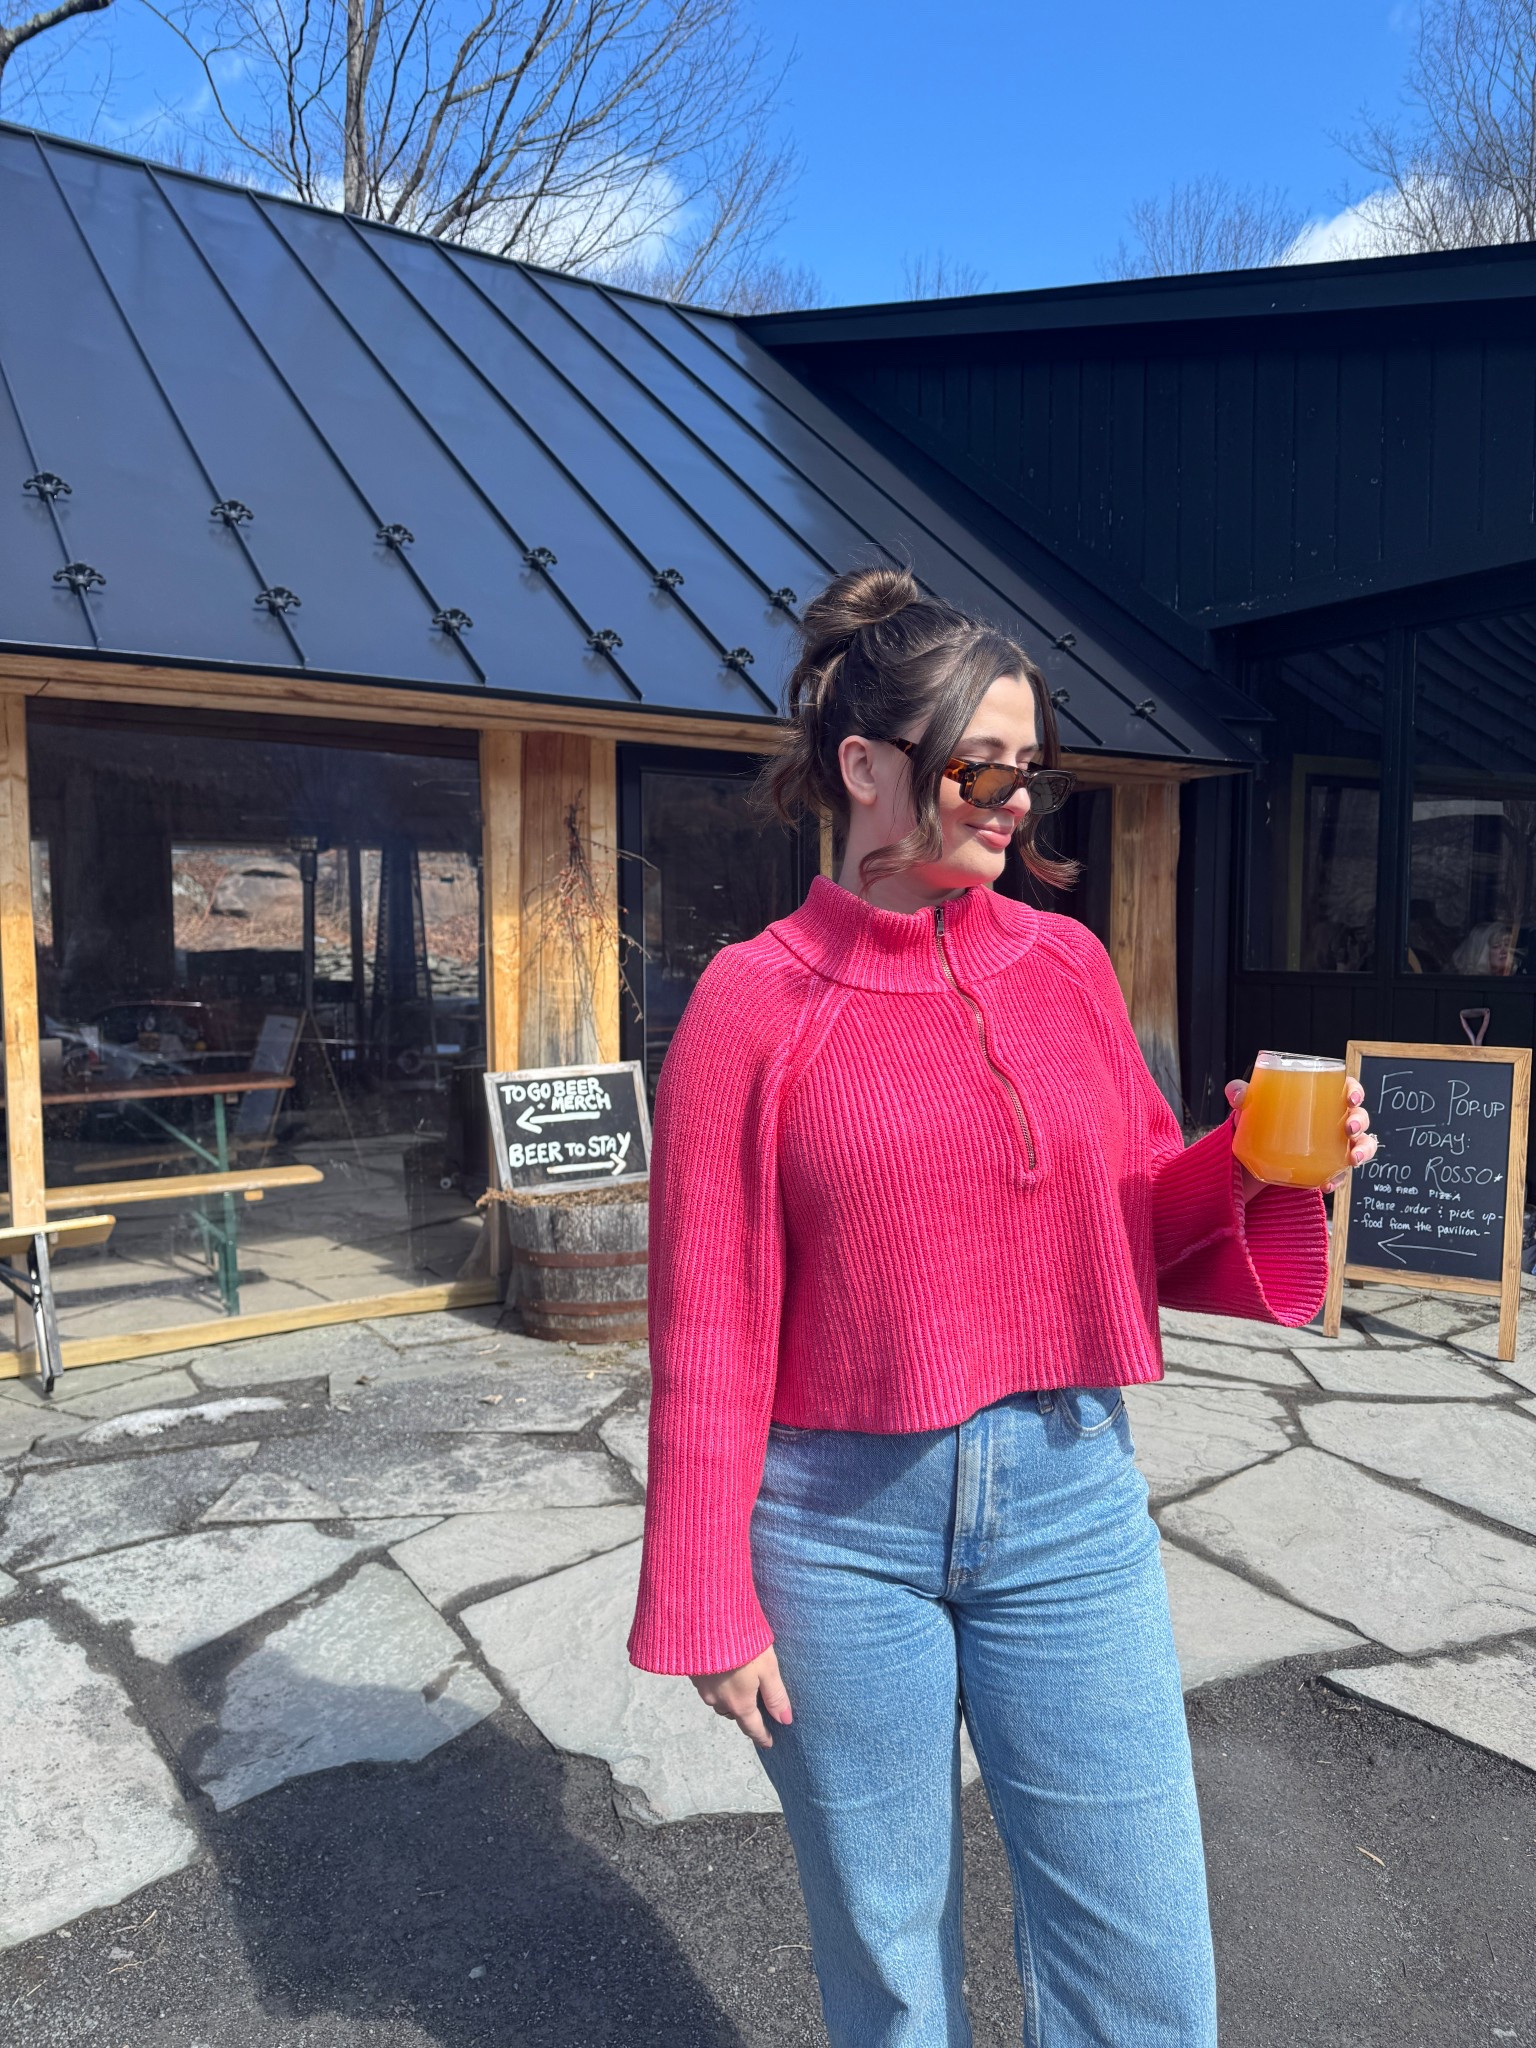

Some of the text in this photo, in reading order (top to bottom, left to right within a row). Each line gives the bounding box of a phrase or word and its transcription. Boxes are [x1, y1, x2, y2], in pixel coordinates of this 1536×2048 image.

[500, 1077, 604, 1105] TO GO BEER
[551, 1093, 612, 1113] MERCH
[1378, 1071, 1435, 1114] FOOD
[508, 1131, 631, 1168] BEER TO STAY
[1428, 1189, 1461, 1202] PIZZA
[1389, 1217, 1411, 1231] from
[1414, 1221, 1433, 1232] the
